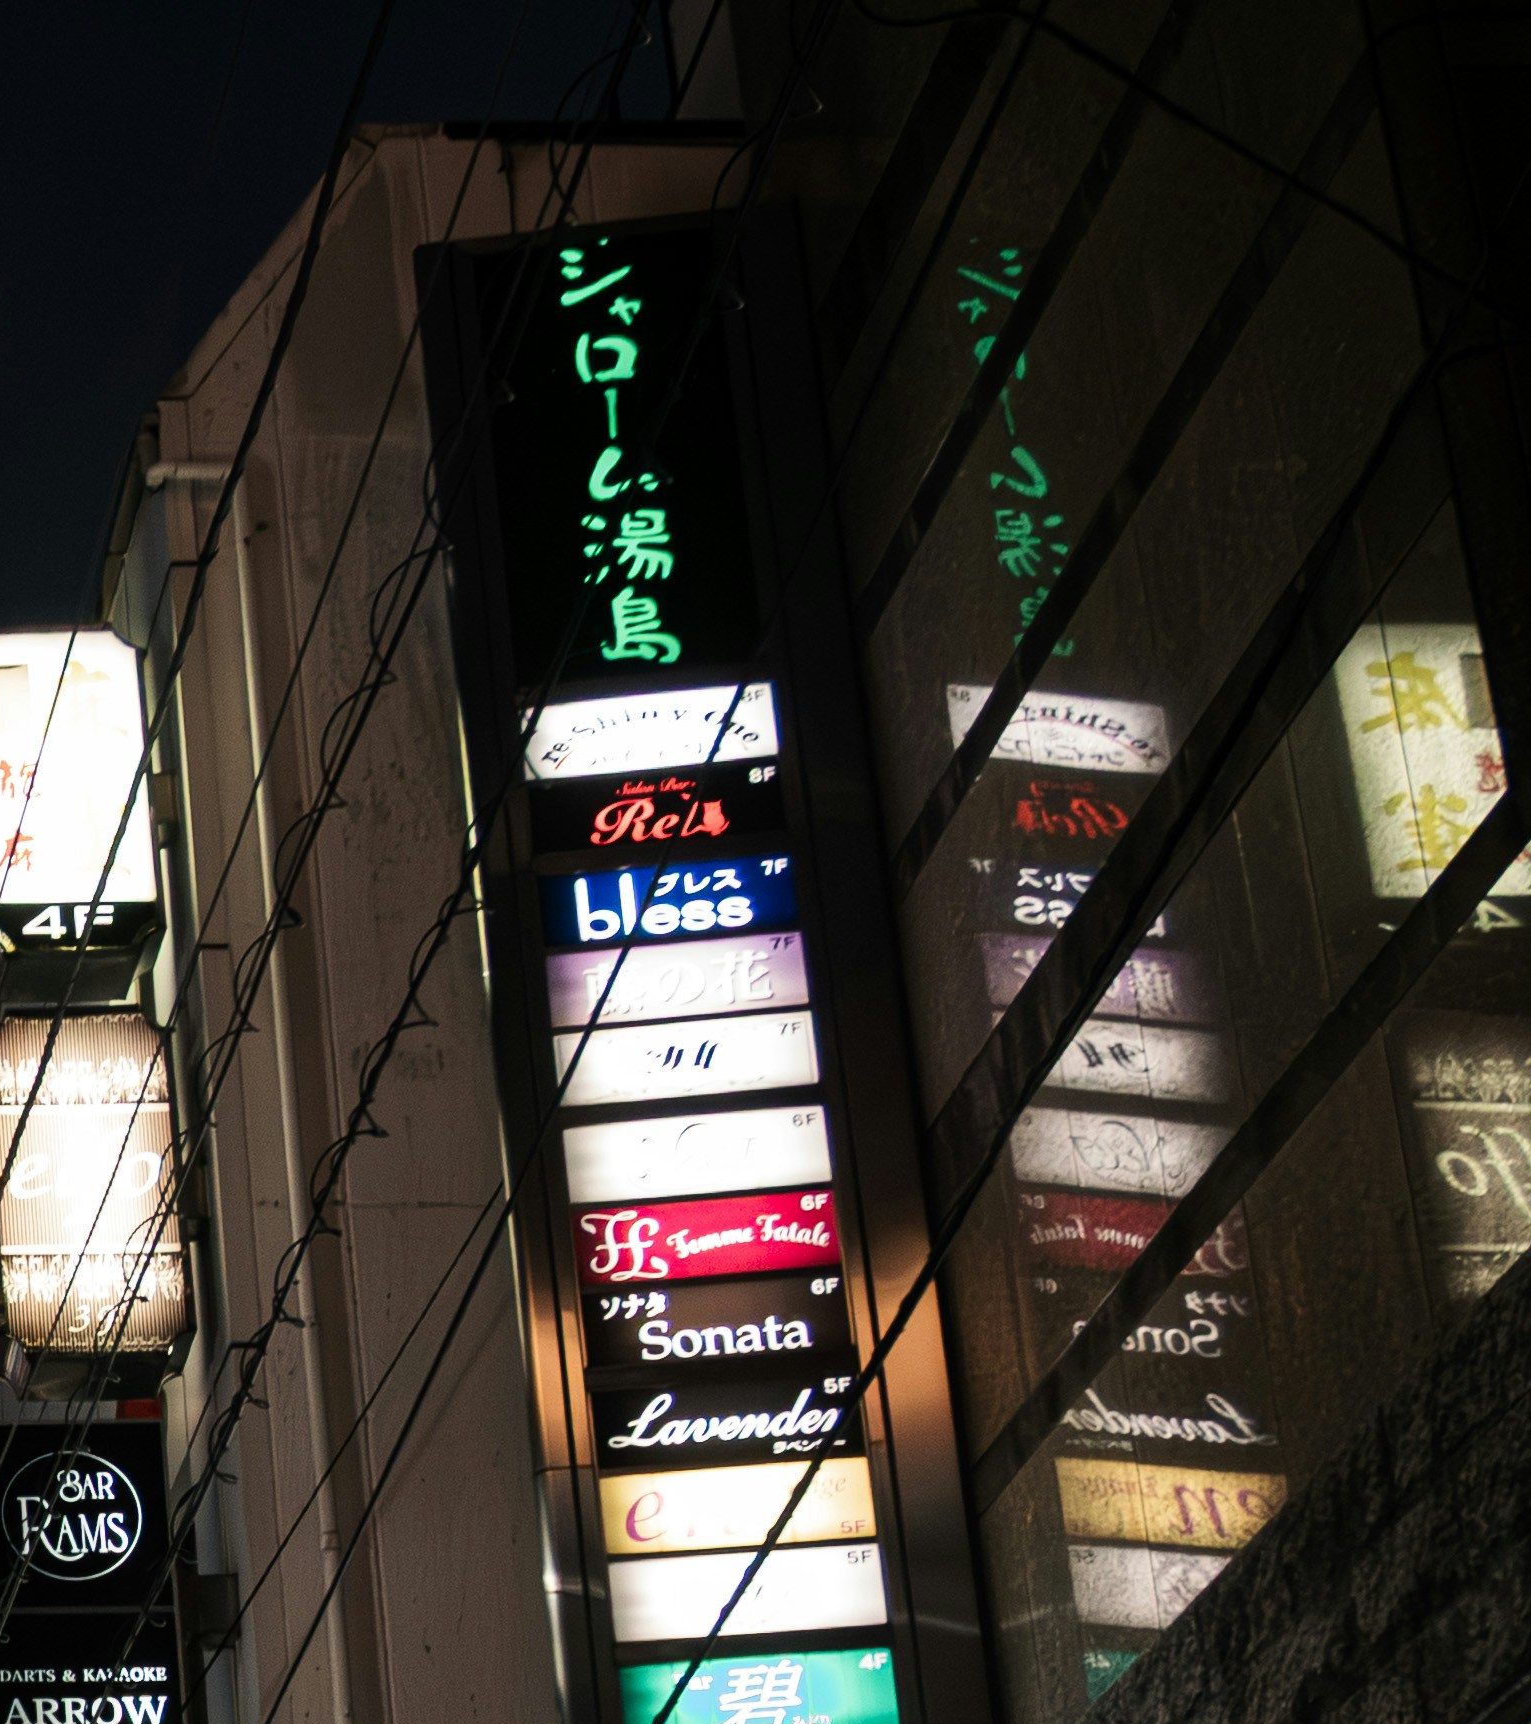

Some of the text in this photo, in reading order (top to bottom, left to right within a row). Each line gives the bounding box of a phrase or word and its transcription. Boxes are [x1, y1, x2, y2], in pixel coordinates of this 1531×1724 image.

[748, 765, 776, 784] 8F
[760, 858, 789, 877] 7F
[574, 872, 754, 942] bless
[768, 935, 798, 951] 7F
[779, 1020, 803, 1036] 7F
[792, 1112, 818, 1127] 6F
[799, 1193, 829, 1212] 6F
[666, 1213, 831, 1260] Femme Fatale
[810, 1277, 839, 1296] 6F
[600, 1292, 668, 1320] ソナタ
[638, 1314, 815, 1361] Sonata
[823, 1376, 852, 1394] 5F
[607, 1388, 843, 1449] Lavender
[57, 1469, 117, 1503] BAR
[16, 1495, 129, 1562] RAMS
[840, 1519, 867, 1534] 5F
[846, 1550, 873, 1565] 5F
[858, 1652, 889, 1671] 4F
[0, 1668, 57, 1684] DARTS
[62, 1669, 77, 1683] &
